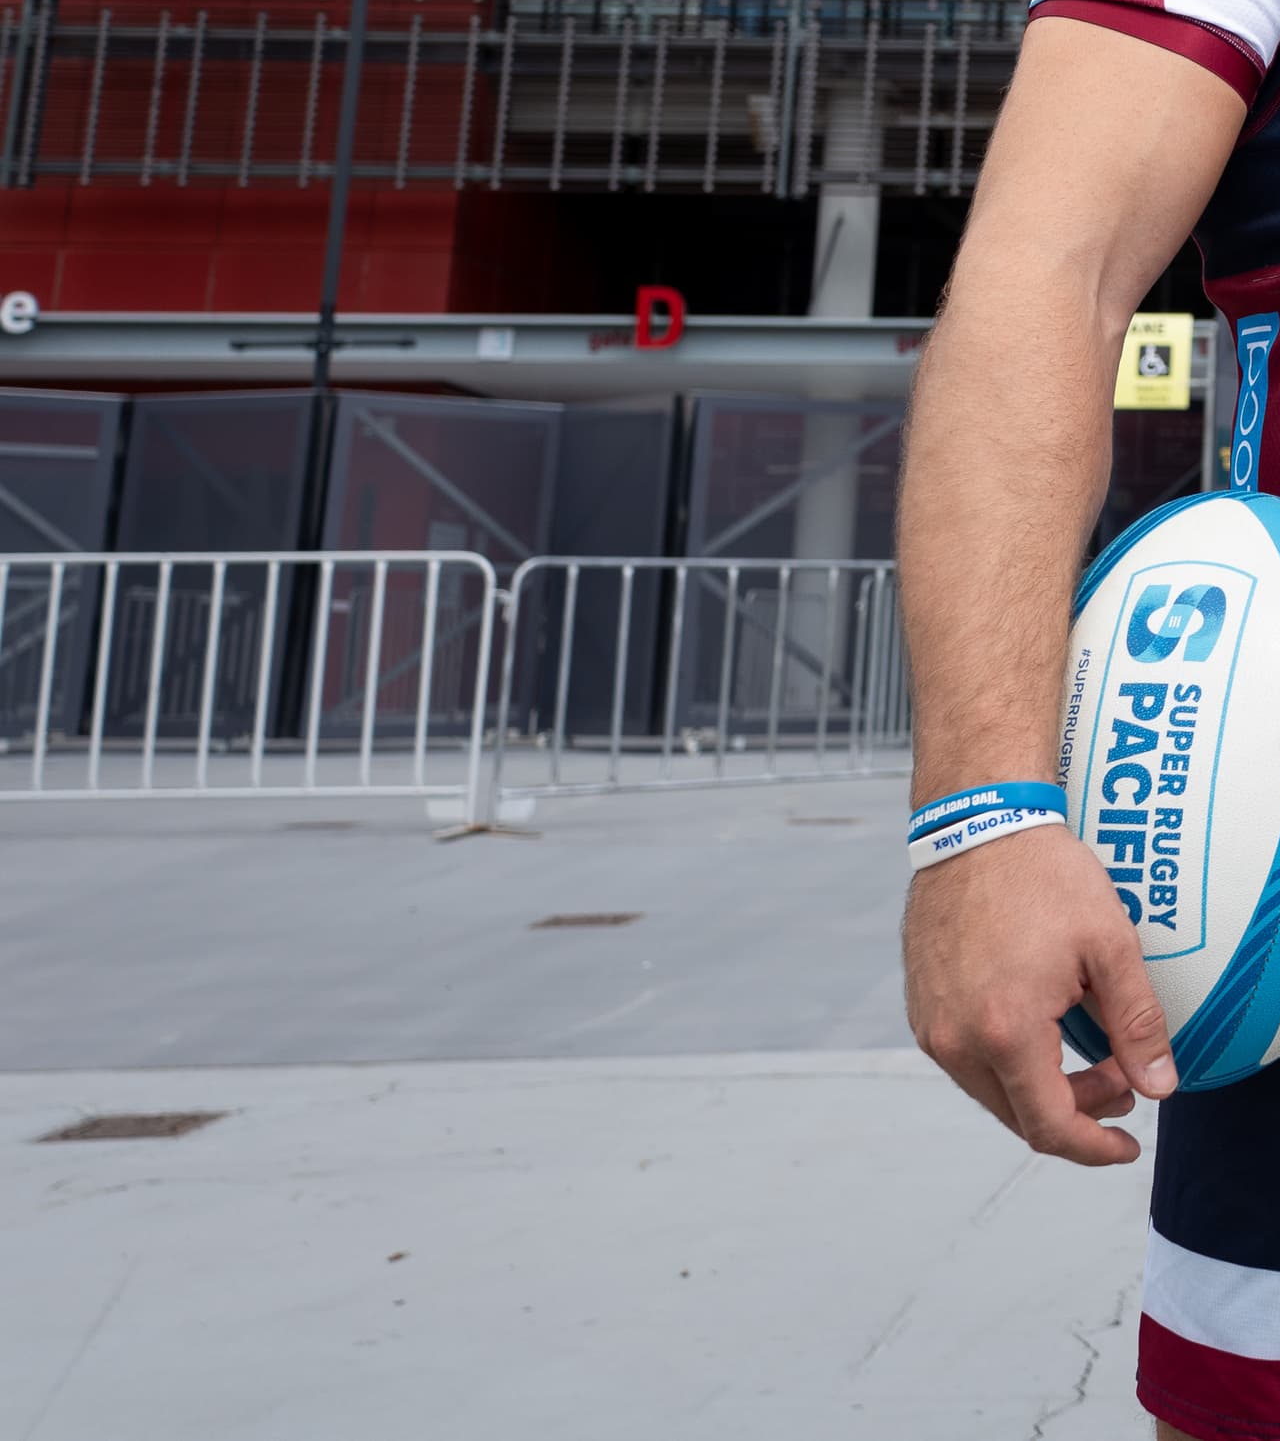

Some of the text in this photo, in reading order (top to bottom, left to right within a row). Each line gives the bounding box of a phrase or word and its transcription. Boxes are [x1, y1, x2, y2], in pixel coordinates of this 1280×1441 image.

[634, 285, 687, 351] D
[1233, 324, 1273, 493] ocal
[924, 796, 971, 823] everyday
[967, 809, 1024, 837] Strong
[1148, 683, 1202, 931] SUPER RUGBY
[933, 830, 963, 851] Alex
